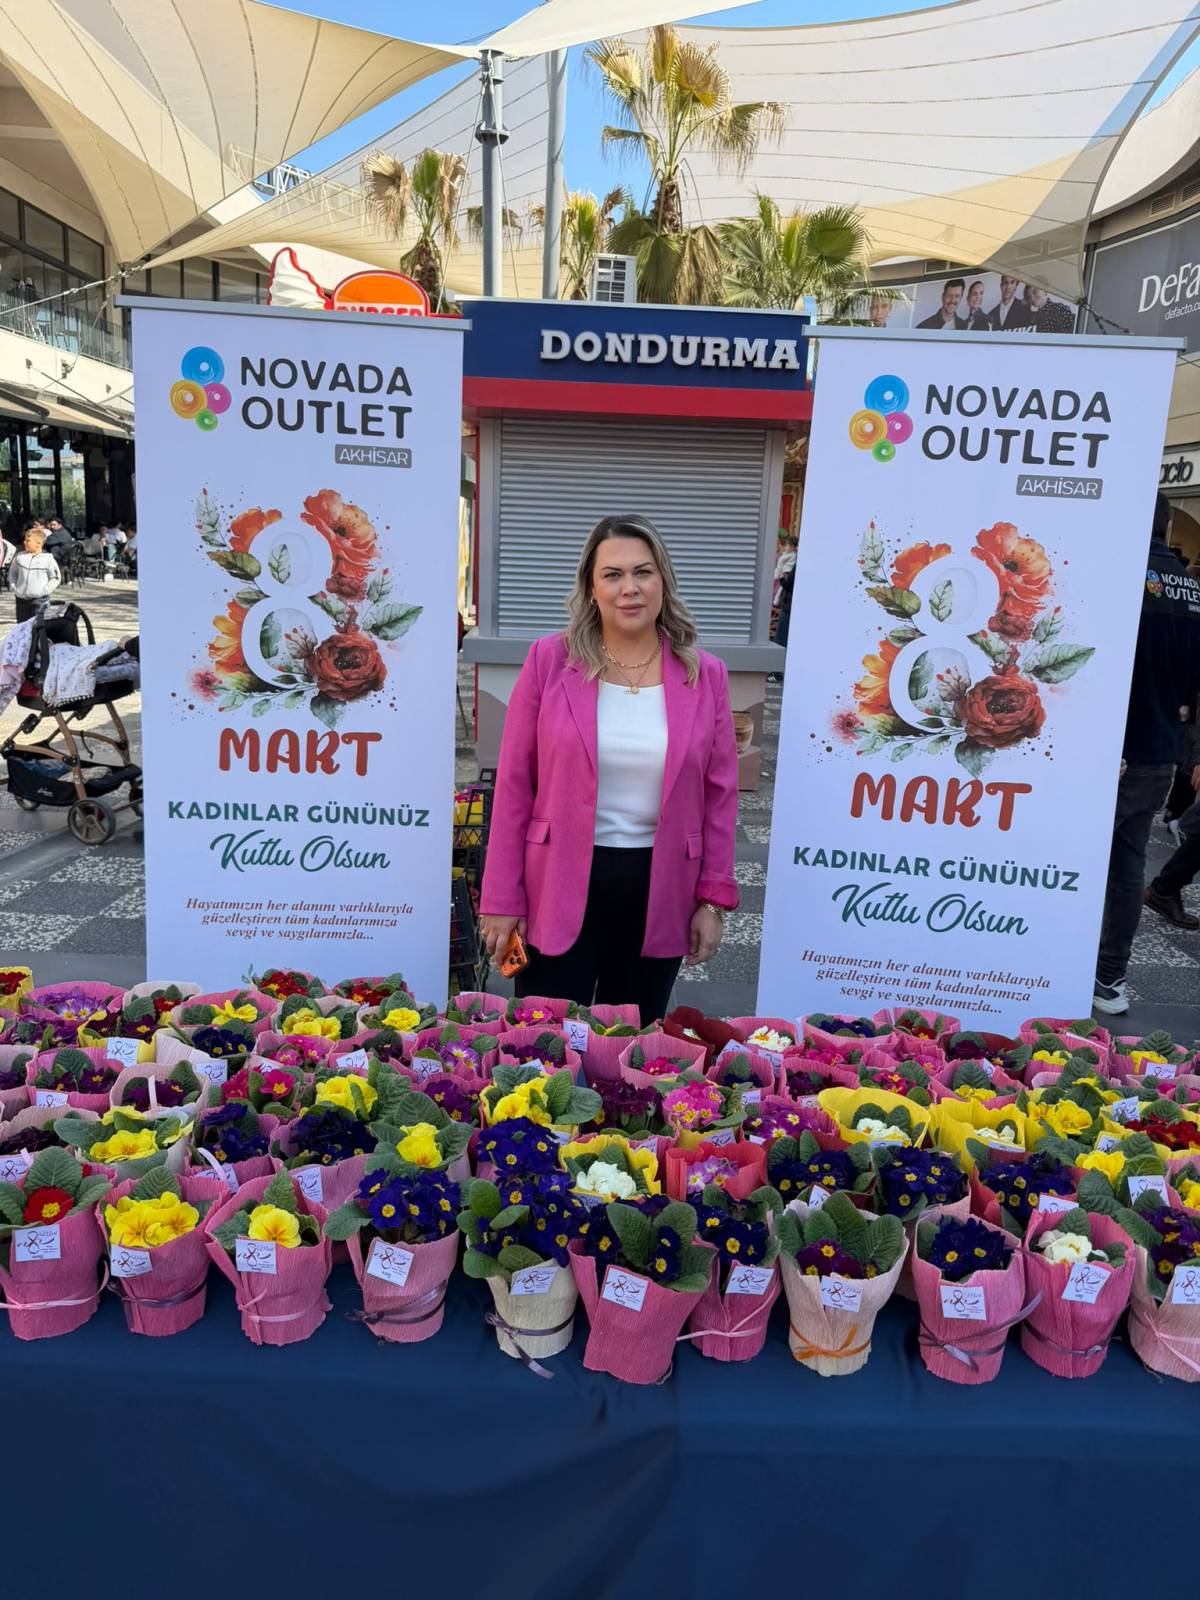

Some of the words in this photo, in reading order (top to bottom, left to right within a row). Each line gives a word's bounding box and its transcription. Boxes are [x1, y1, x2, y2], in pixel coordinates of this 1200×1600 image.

[540, 329, 800, 370] DONDURMA
[241, 356, 413, 396] NOVADA
[242, 396, 413, 439] OUTLET
[925, 384, 1111, 422] NOVADA
[339, 447, 408, 466] AKHİSAR
[922, 425, 1109, 468] OUTLET
[1020, 476, 1098, 496] AKHİSAR
[219, 727, 382, 776] MART
[168, 801, 299, 822] KADINLAR
[307, 801, 430, 827] GÜNÜNÜZ
[850, 772, 1033, 831] MART
[210, 829, 294, 872] Kutlu
[300, 835, 390, 872] Olsun
[793, 847, 931, 877] KADINLAR
[939, 856, 1080, 891] GÜNÜNÜZ
[266, 899, 288, 911] her
[285, 913, 310, 925] tüm
[832, 882, 921, 927] Kutlu
[926, 893, 1029, 935] Olsun
[225, 928, 258, 940] sevgi
[261, 928, 275, 938] ve
[802, 950, 883, 971] Hayatımızın
[886, 959, 910, 973] her
[840, 984, 875, 1000] sevgi
[878, 991, 892, 1001] ve
[905, 976, 932, 990] tüm
